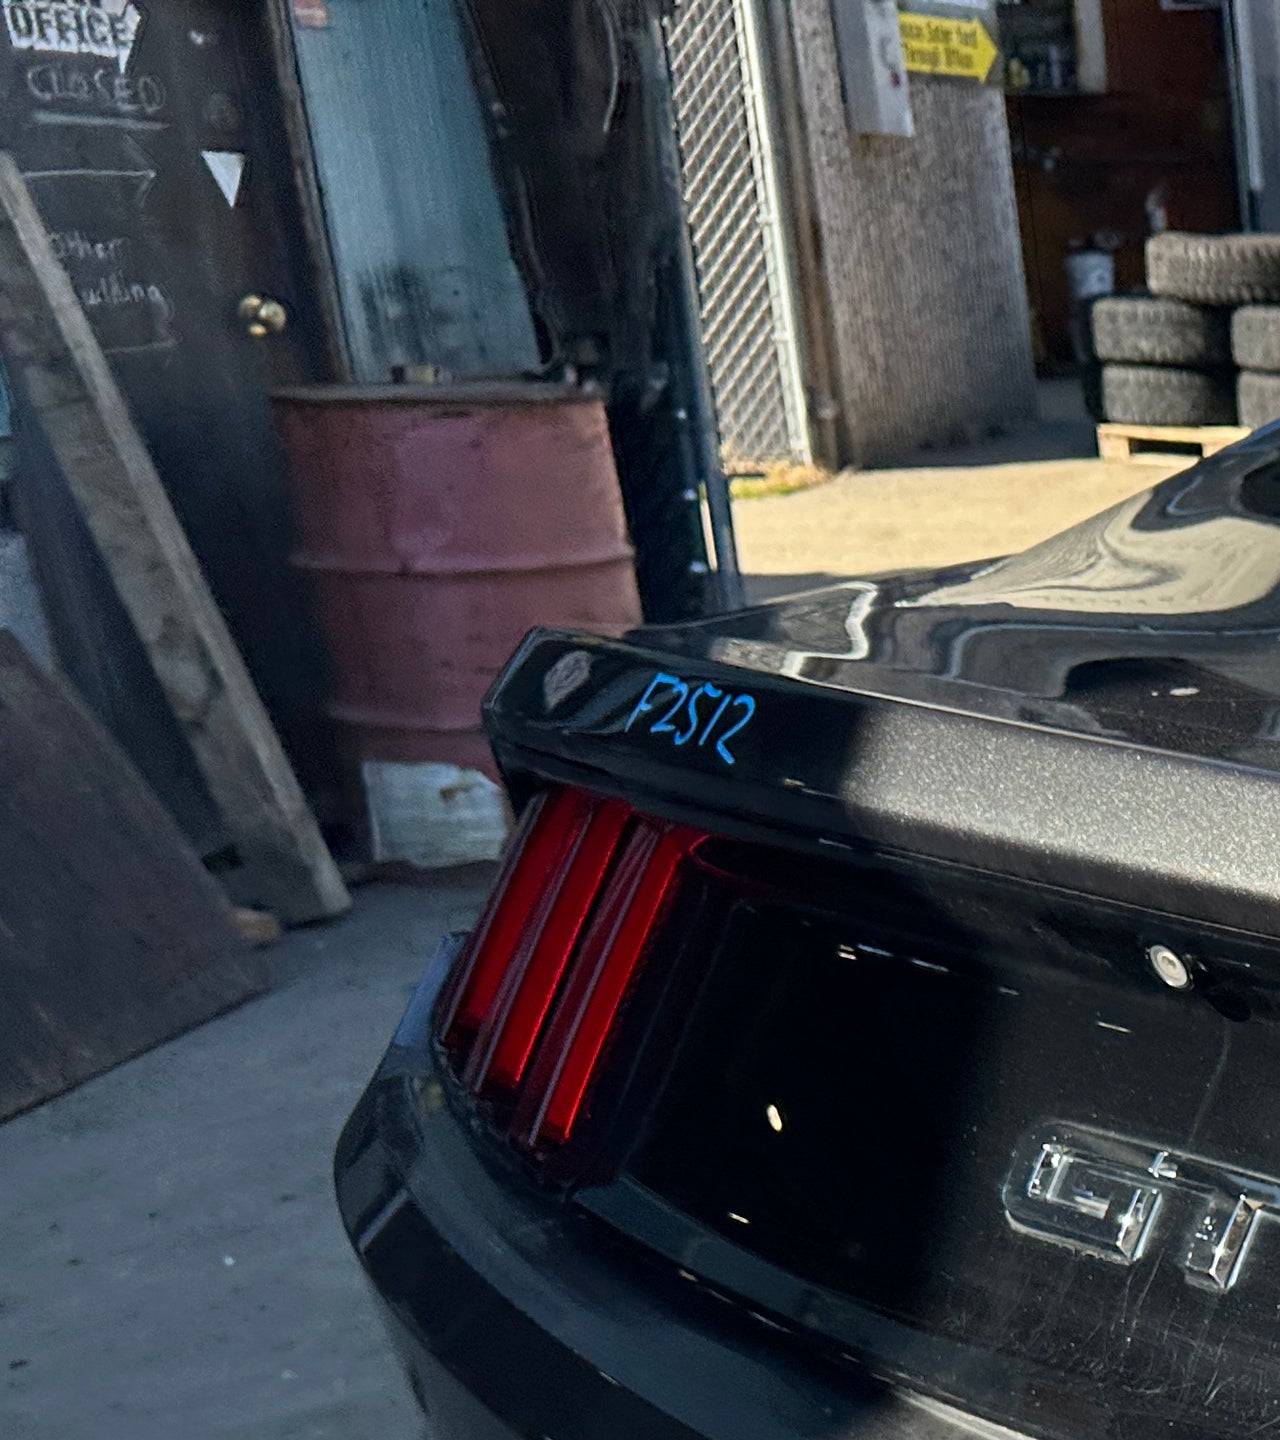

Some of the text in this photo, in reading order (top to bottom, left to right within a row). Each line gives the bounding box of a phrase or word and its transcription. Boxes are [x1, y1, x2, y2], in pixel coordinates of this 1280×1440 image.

[9, 5, 134, 50] OFFICE
[27, 64, 166, 113] CLOSED
[624, 672, 757, 765] F2512
